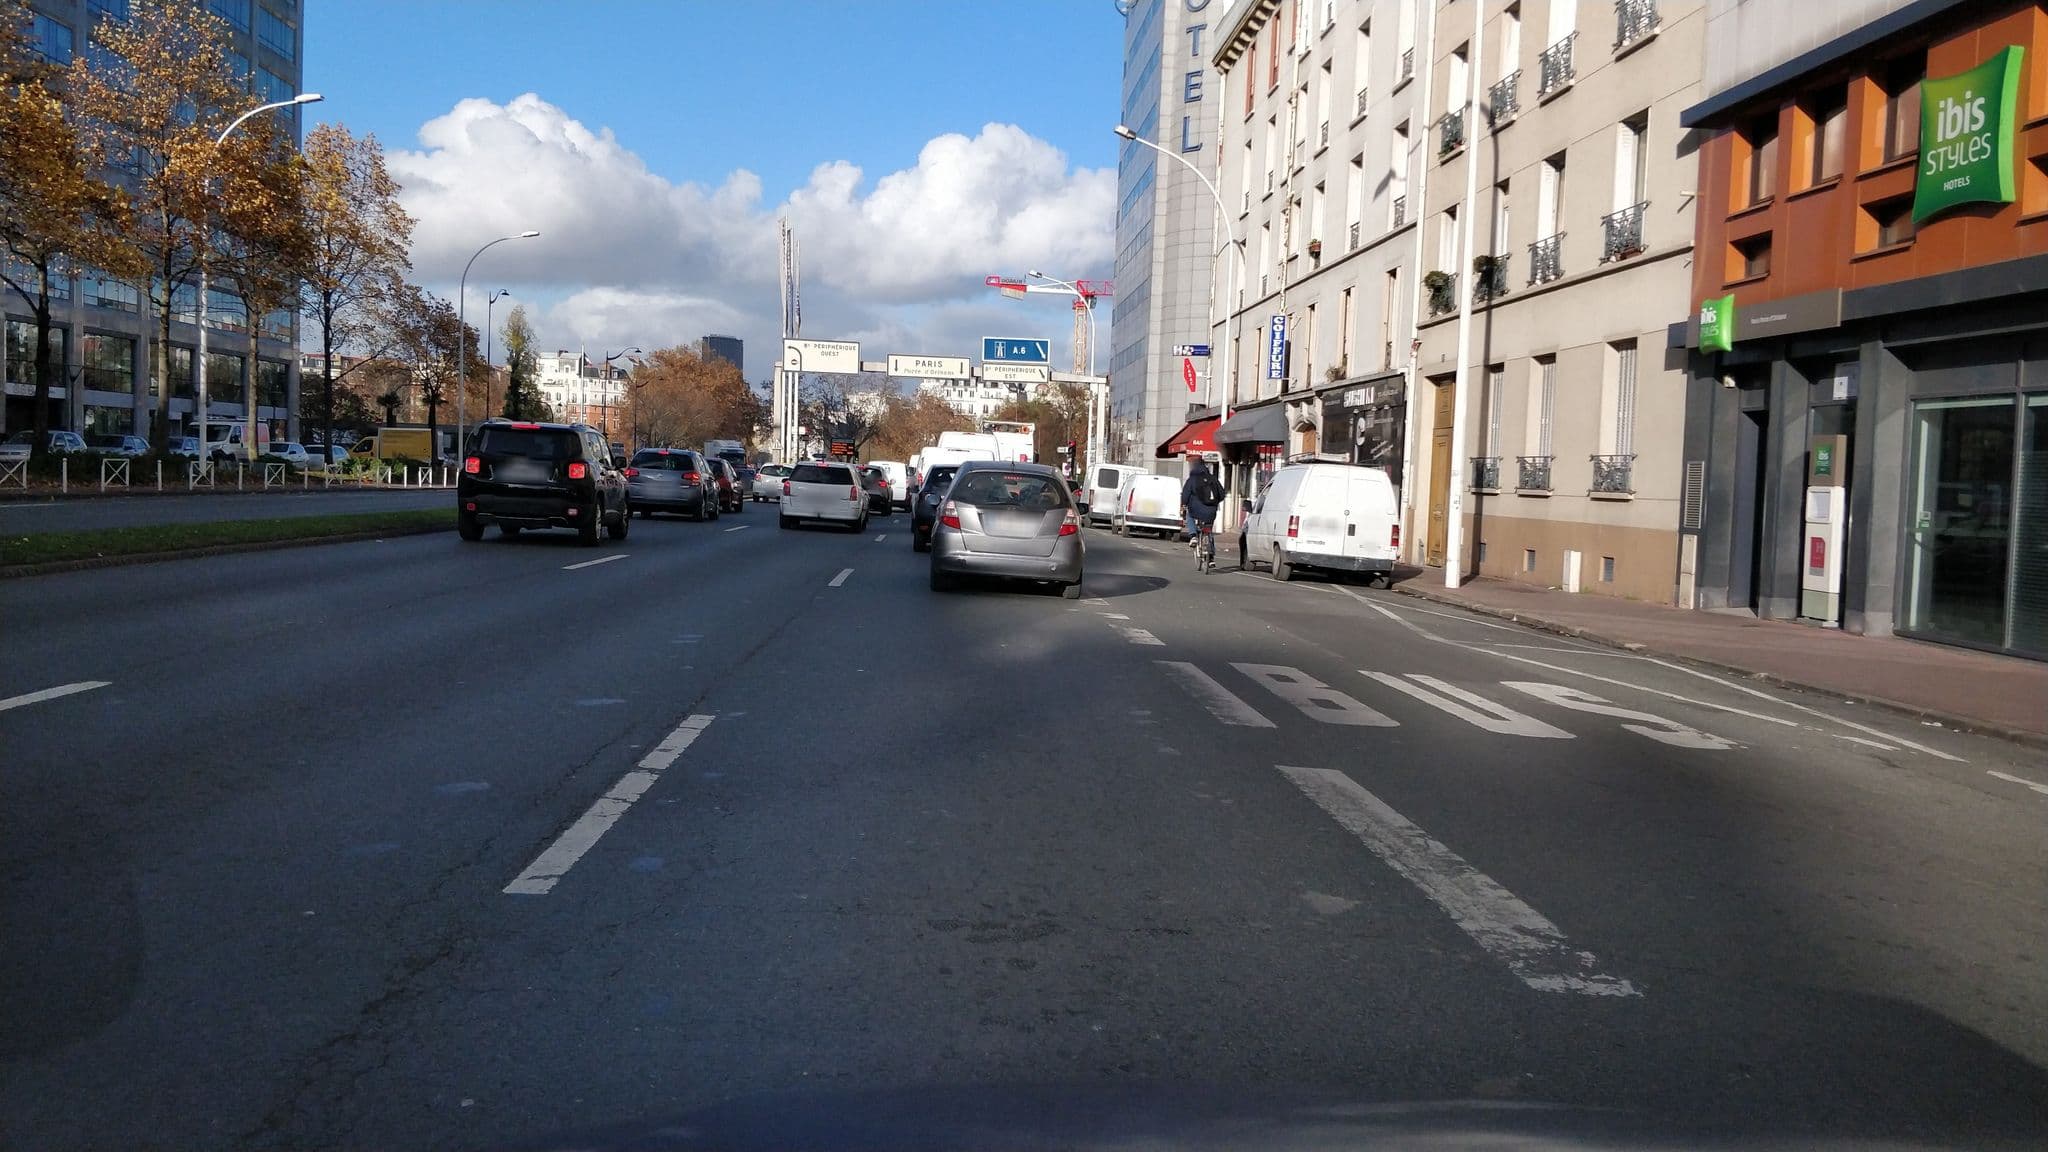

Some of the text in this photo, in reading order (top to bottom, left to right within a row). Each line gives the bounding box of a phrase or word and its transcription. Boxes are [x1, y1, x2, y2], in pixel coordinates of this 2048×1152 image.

[1936, 91, 1986, 143] ibis
[1943, 176, 1971, 192] HOTELS
[915, 360, 943, 368] PARIS
[1270, 316, 1284, 378] COIFFURE
[1229, 662, 1746, 751] BUS
